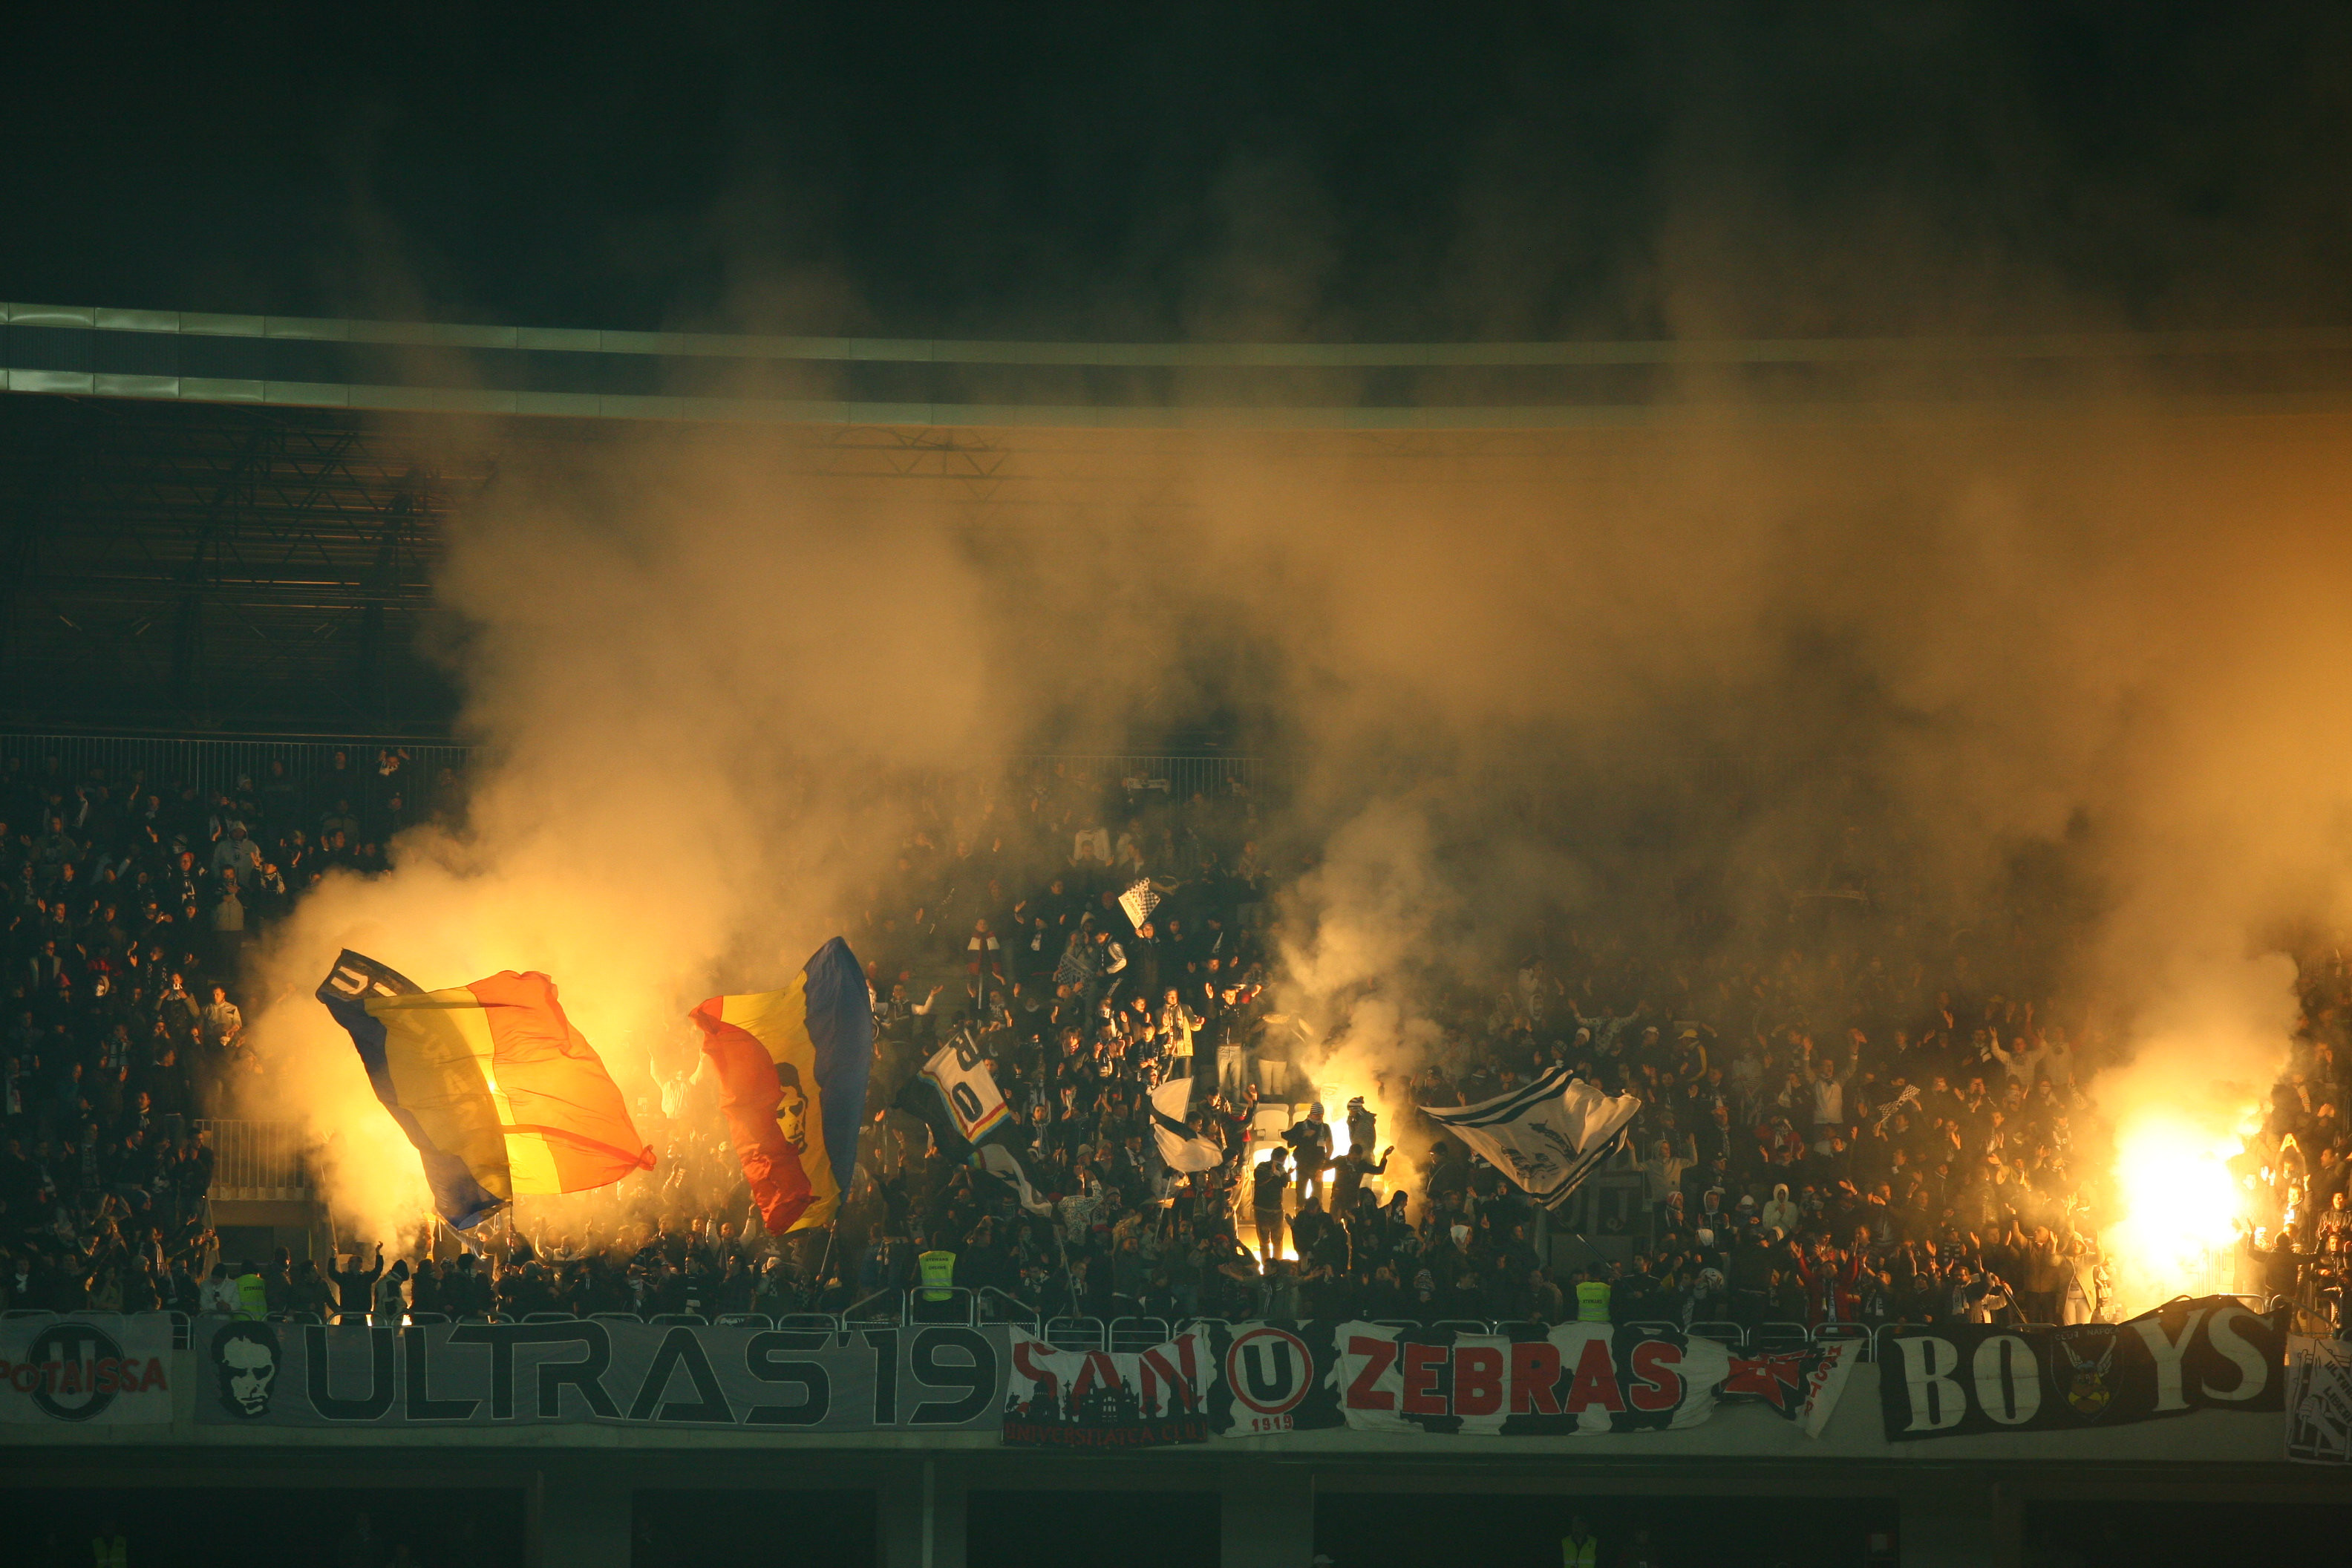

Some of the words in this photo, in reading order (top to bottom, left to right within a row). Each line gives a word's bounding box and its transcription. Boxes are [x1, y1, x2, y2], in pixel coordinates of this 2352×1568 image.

[1243, 1341, 1293, 1402] U
[1346, 1337, 1684, 1416] ZEBRAS
[1252, 1414, 1294, 1433] 1919
